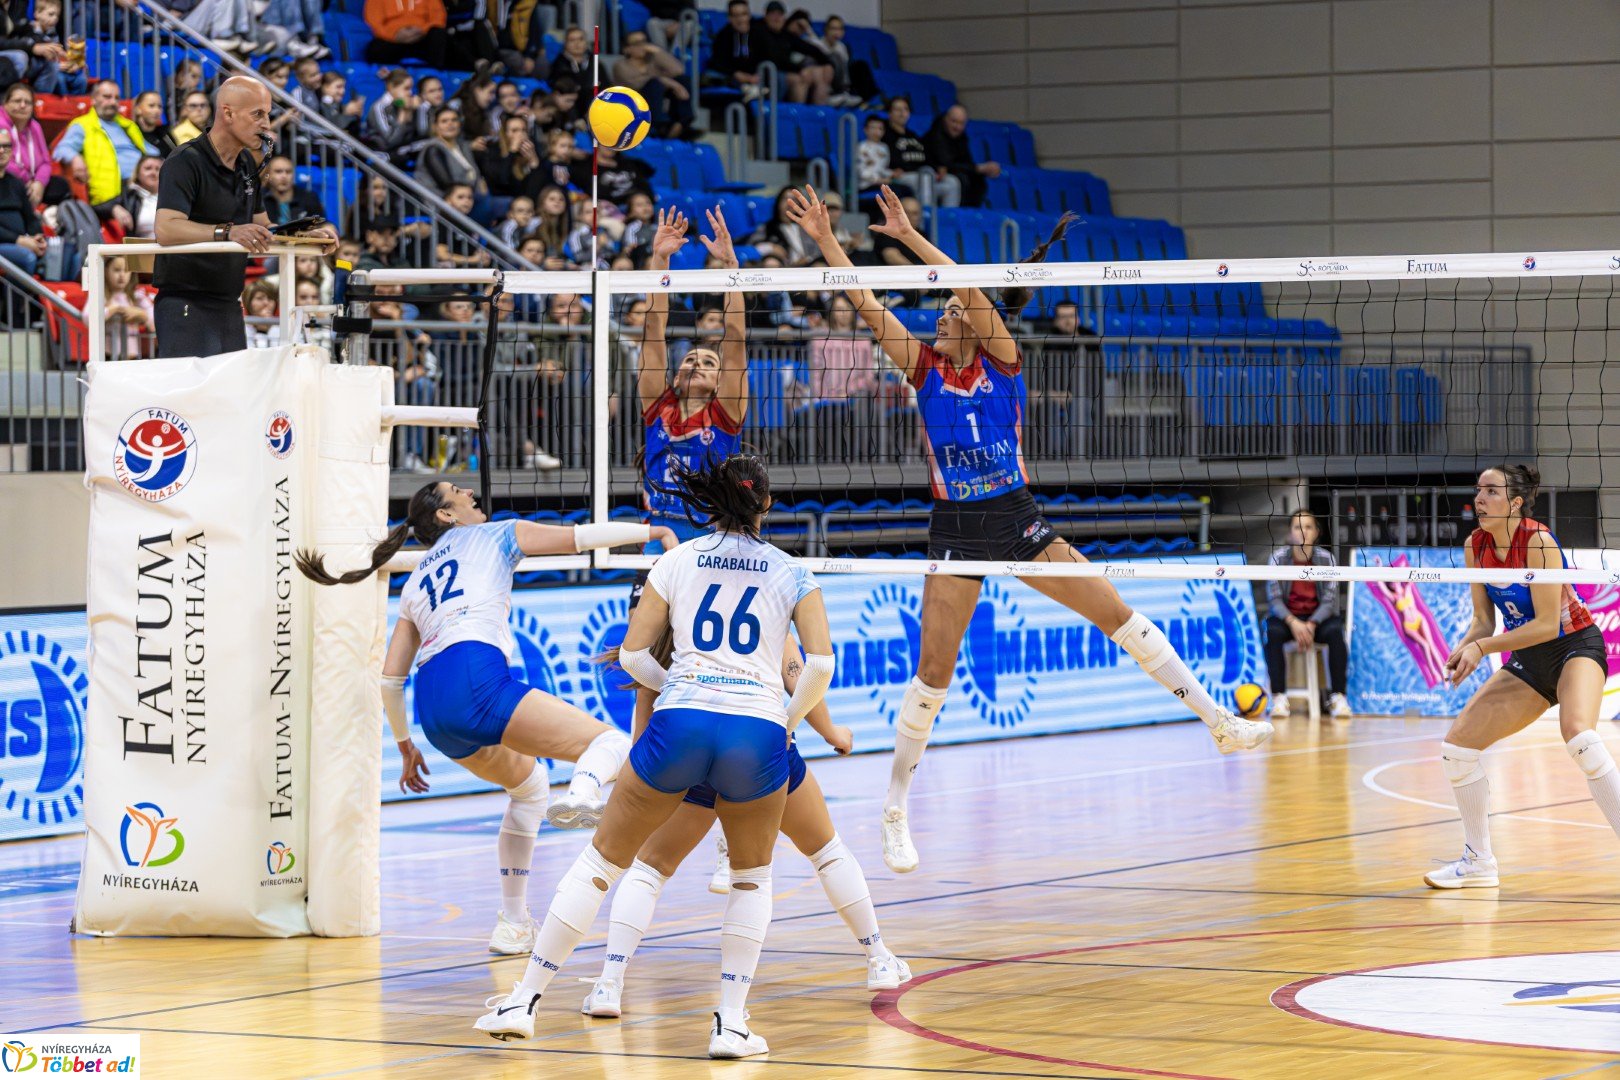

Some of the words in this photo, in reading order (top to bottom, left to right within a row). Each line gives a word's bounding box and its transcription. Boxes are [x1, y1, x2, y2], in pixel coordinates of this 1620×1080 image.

[822, 271, 859, 284] FATUM
[1102, 265, 1142, 280] FATUM
[1406, 259, 1448, 272] FATUM
[148, 409, 188, 434] FATUM
[966, 412, 980, 443] 1
[943, 439, 1013, 469] FATUM
[697, 554, 769, 573] CARABALLO
[419, 559, 464, 612] 12
[692, 583, 761, 655] 66
[117, 528, 174, 764] FATUM
[181, 530, 207, 765] NYÍREGYHÁZA
[103, 874, 199, 892] NYÍREGYHÁZA
[260, 877, 303, 887] NYÍREGYHÁZA
